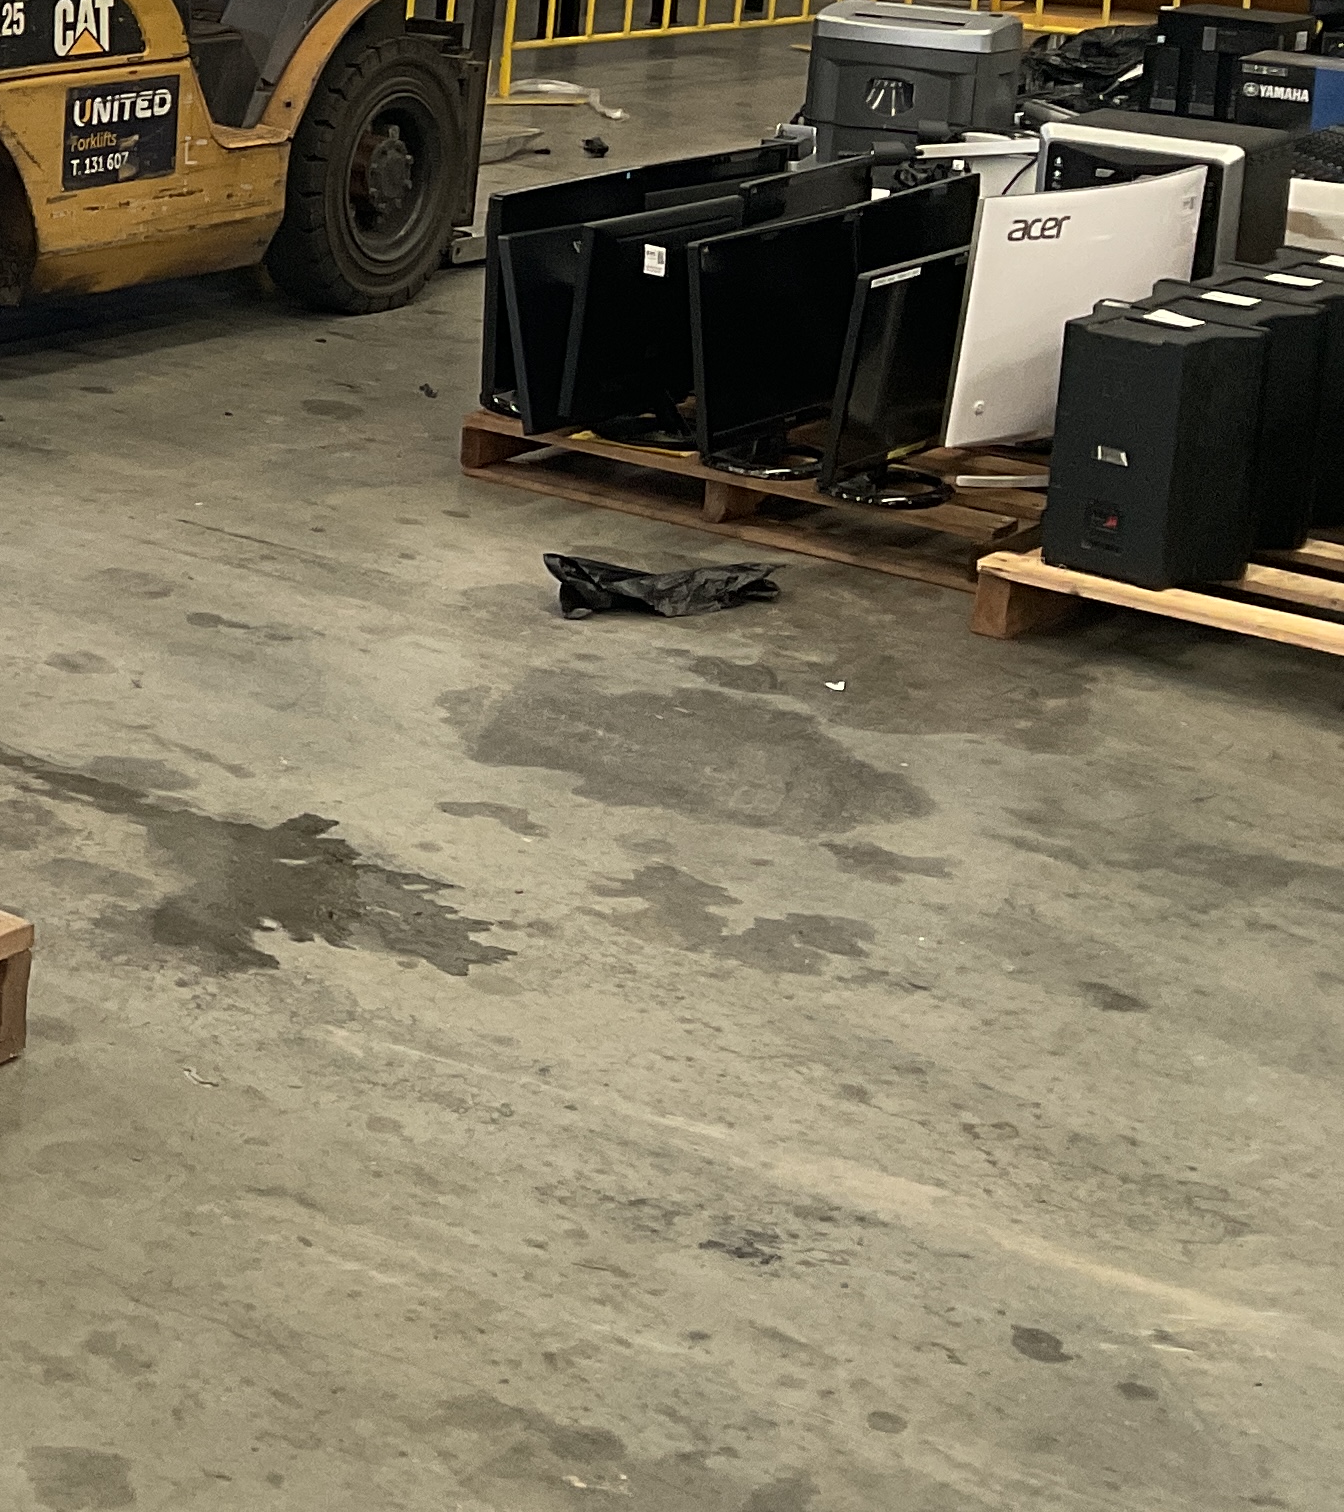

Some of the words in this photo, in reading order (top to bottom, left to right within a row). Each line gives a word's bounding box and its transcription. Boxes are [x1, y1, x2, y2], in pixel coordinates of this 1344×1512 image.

[1, 1, 25, 37] 25
[1259, 84, 1310, 103] YAMAHA
[73, 88, 172, 127] UNITED
[84, 156, 105, 174] 131
[107, 151, 129, 170] 607
[1007, 215, 1072, 242] acer
